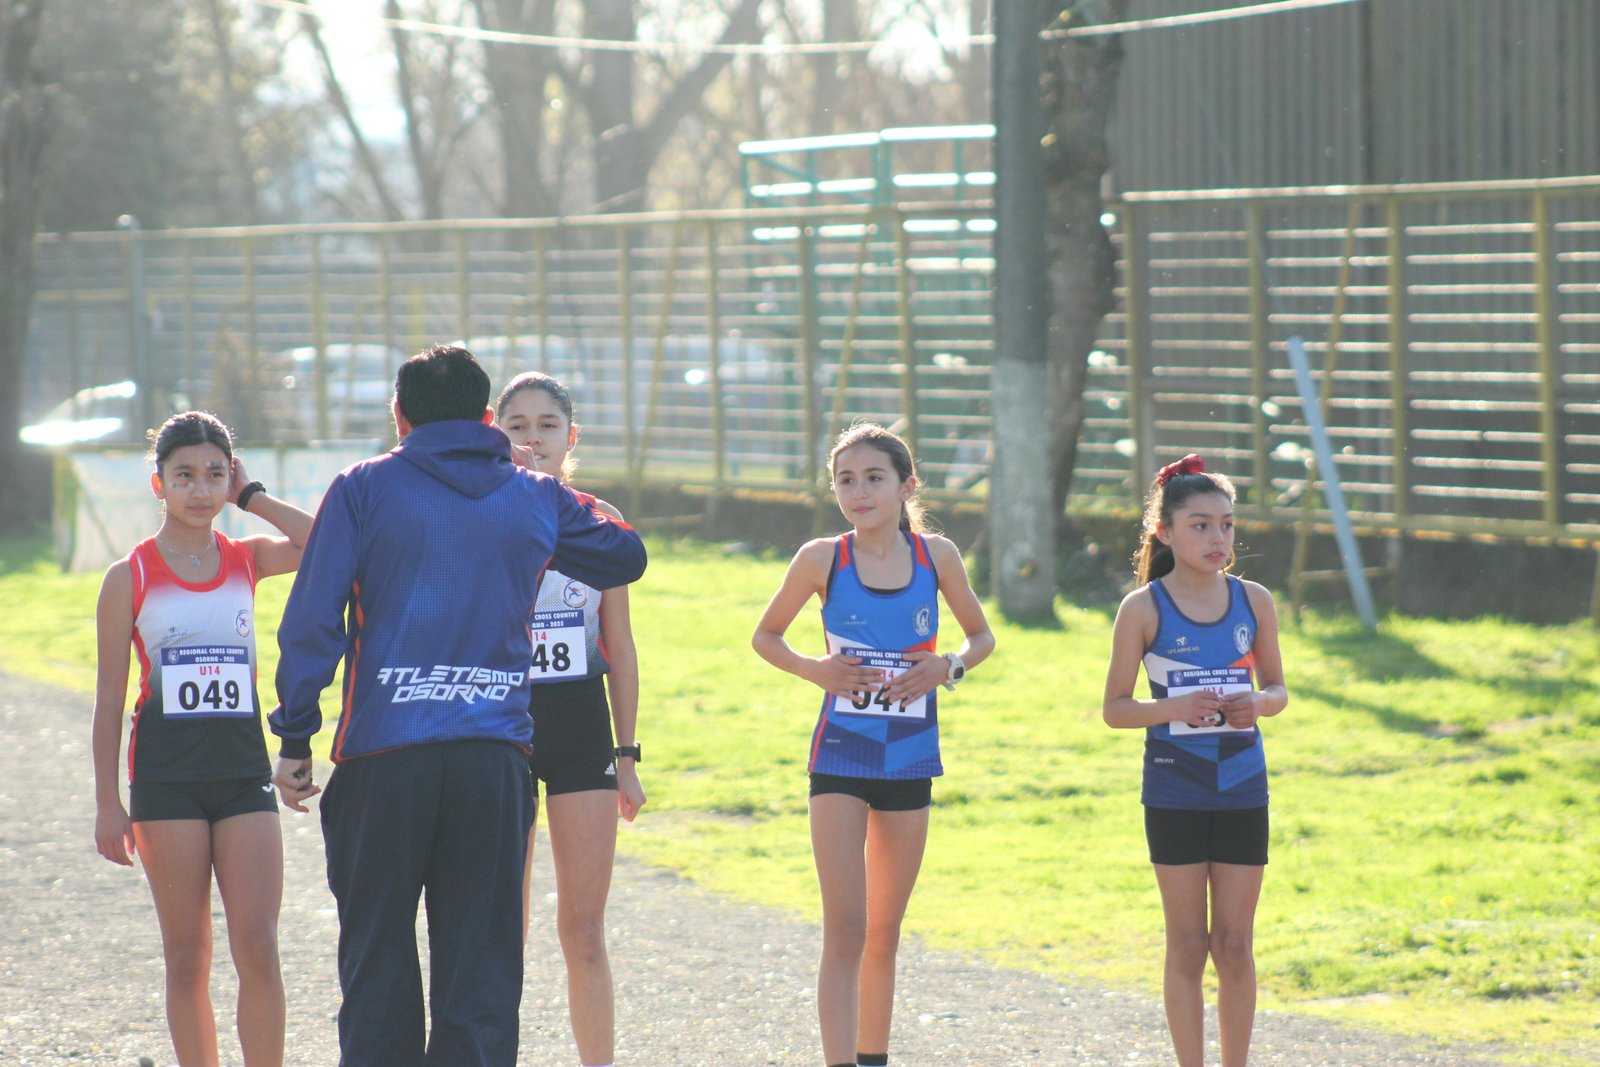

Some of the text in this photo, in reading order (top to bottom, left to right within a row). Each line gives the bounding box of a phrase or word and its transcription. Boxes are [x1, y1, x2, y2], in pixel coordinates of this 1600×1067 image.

[534, 631, 547, 641] 14
[532, 642, 570, 672] 48
[856, 650, 883, 658] REGIONAL
[200, 665, 221, 676] U14
[376, 664, 525, 687] ATLETISMO
[1183, 669, 1211, 678] REGIONAL
[178, 680, 240, 710] 049
[391, 682, 511, 705] OSORNO
